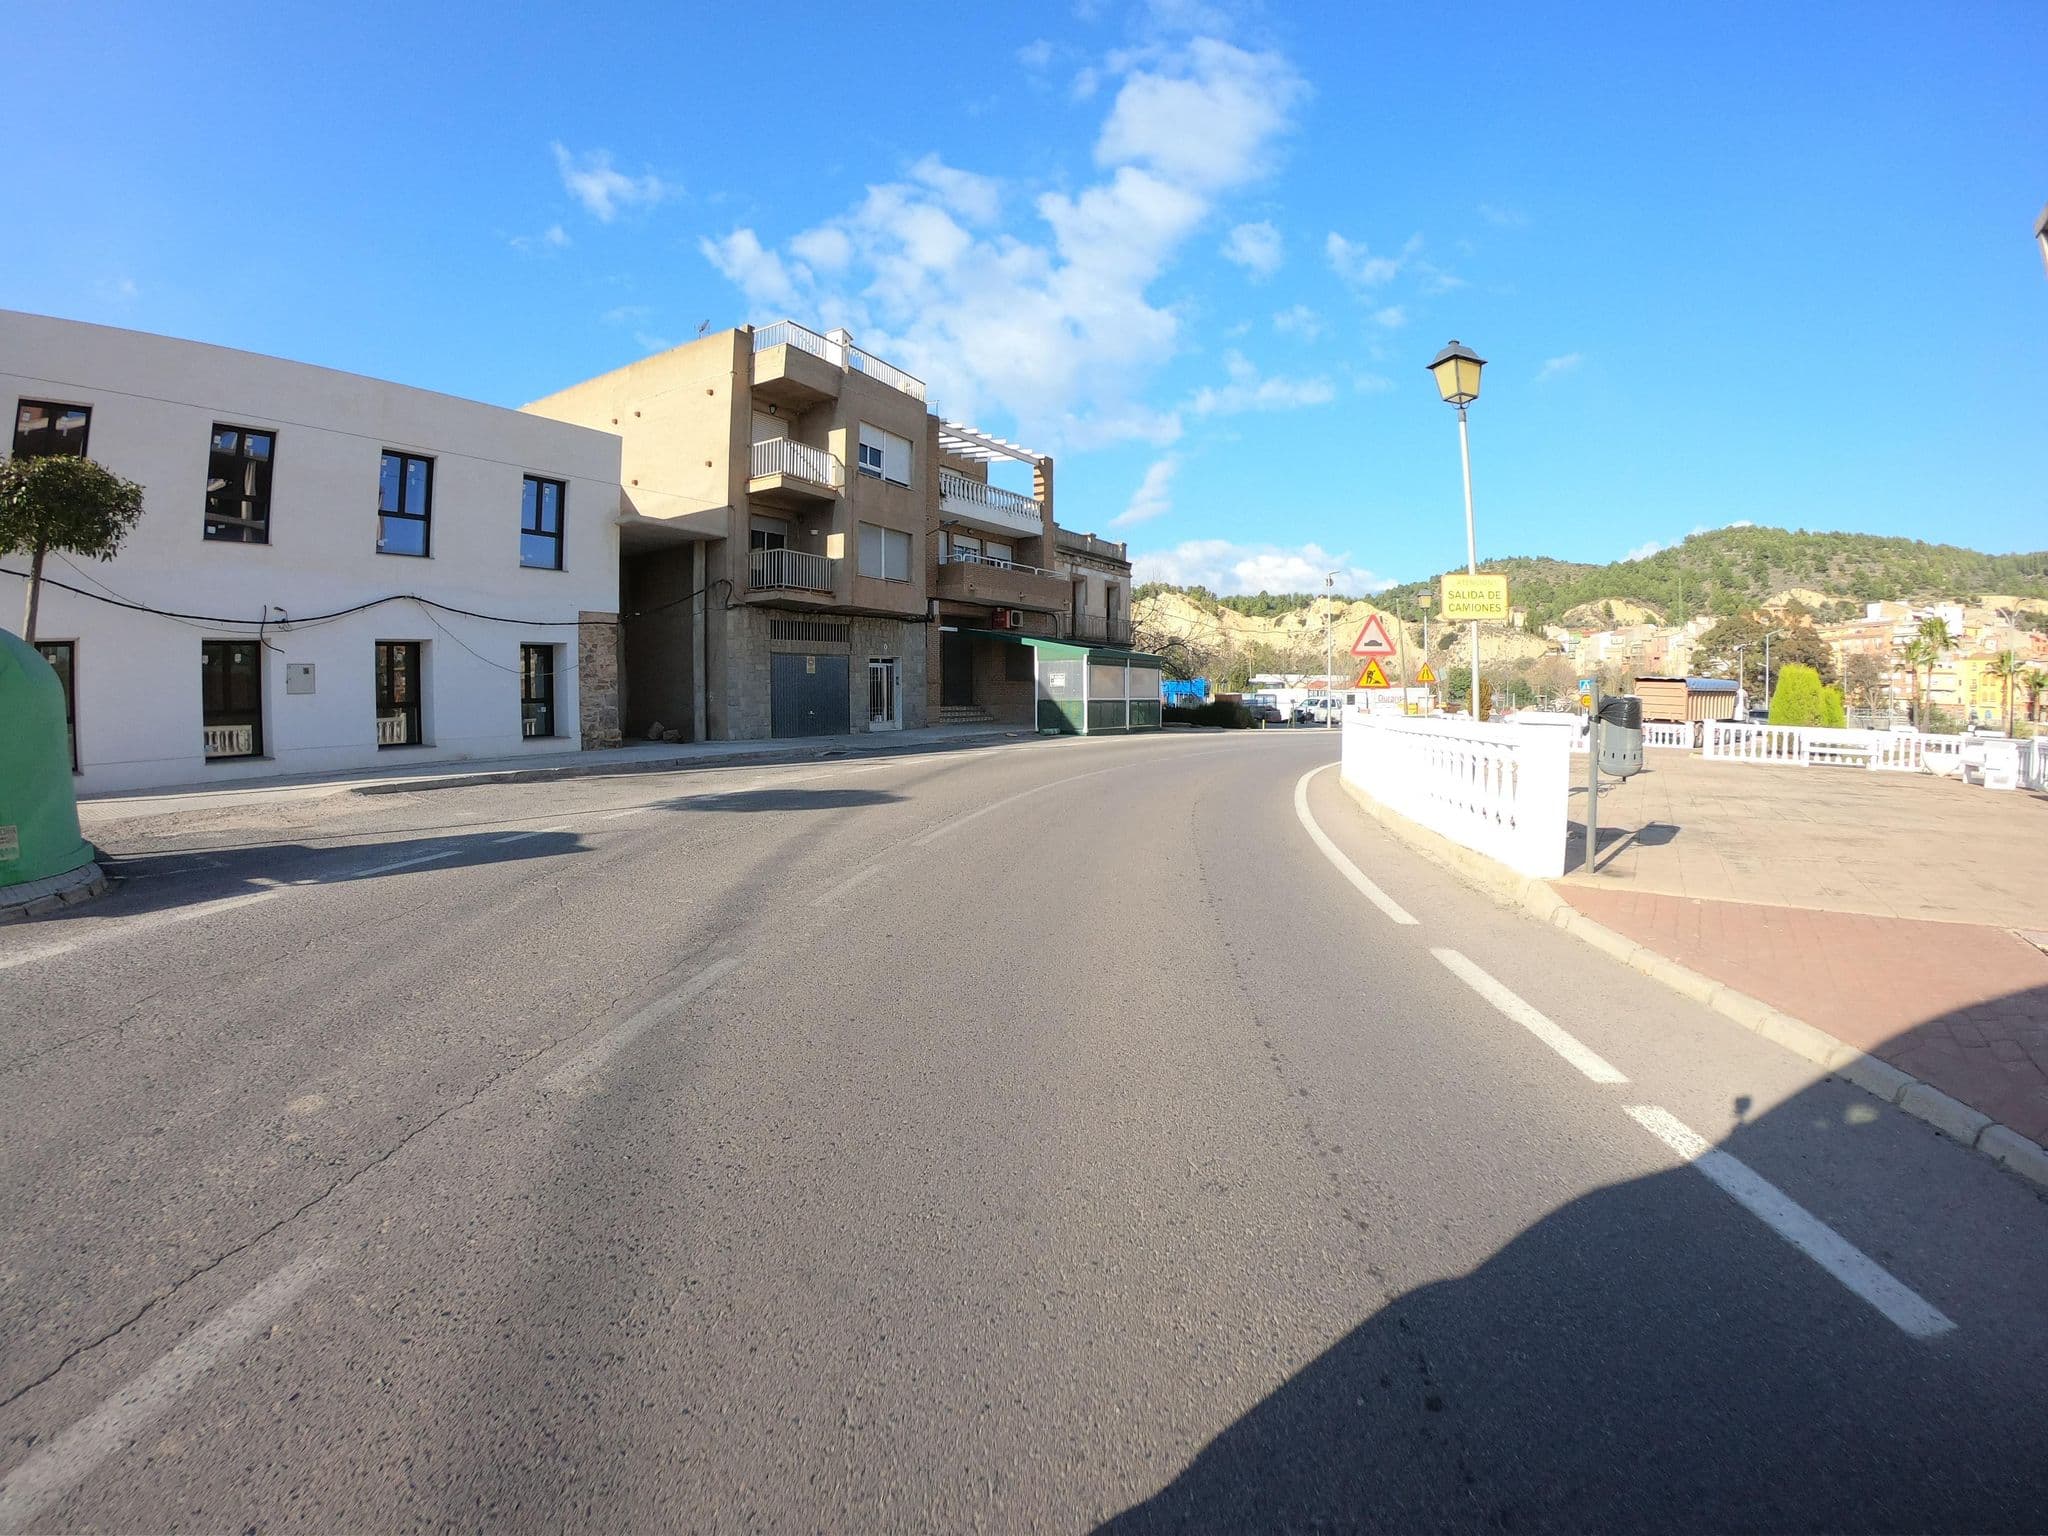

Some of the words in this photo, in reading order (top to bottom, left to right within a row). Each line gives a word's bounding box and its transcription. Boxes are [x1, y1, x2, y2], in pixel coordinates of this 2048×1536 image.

[1448, 590, 1485, 600] SALIDA
[1487, 590, 1503, 600] DE
[1448, 602, 1502, 613] CAMIONES
